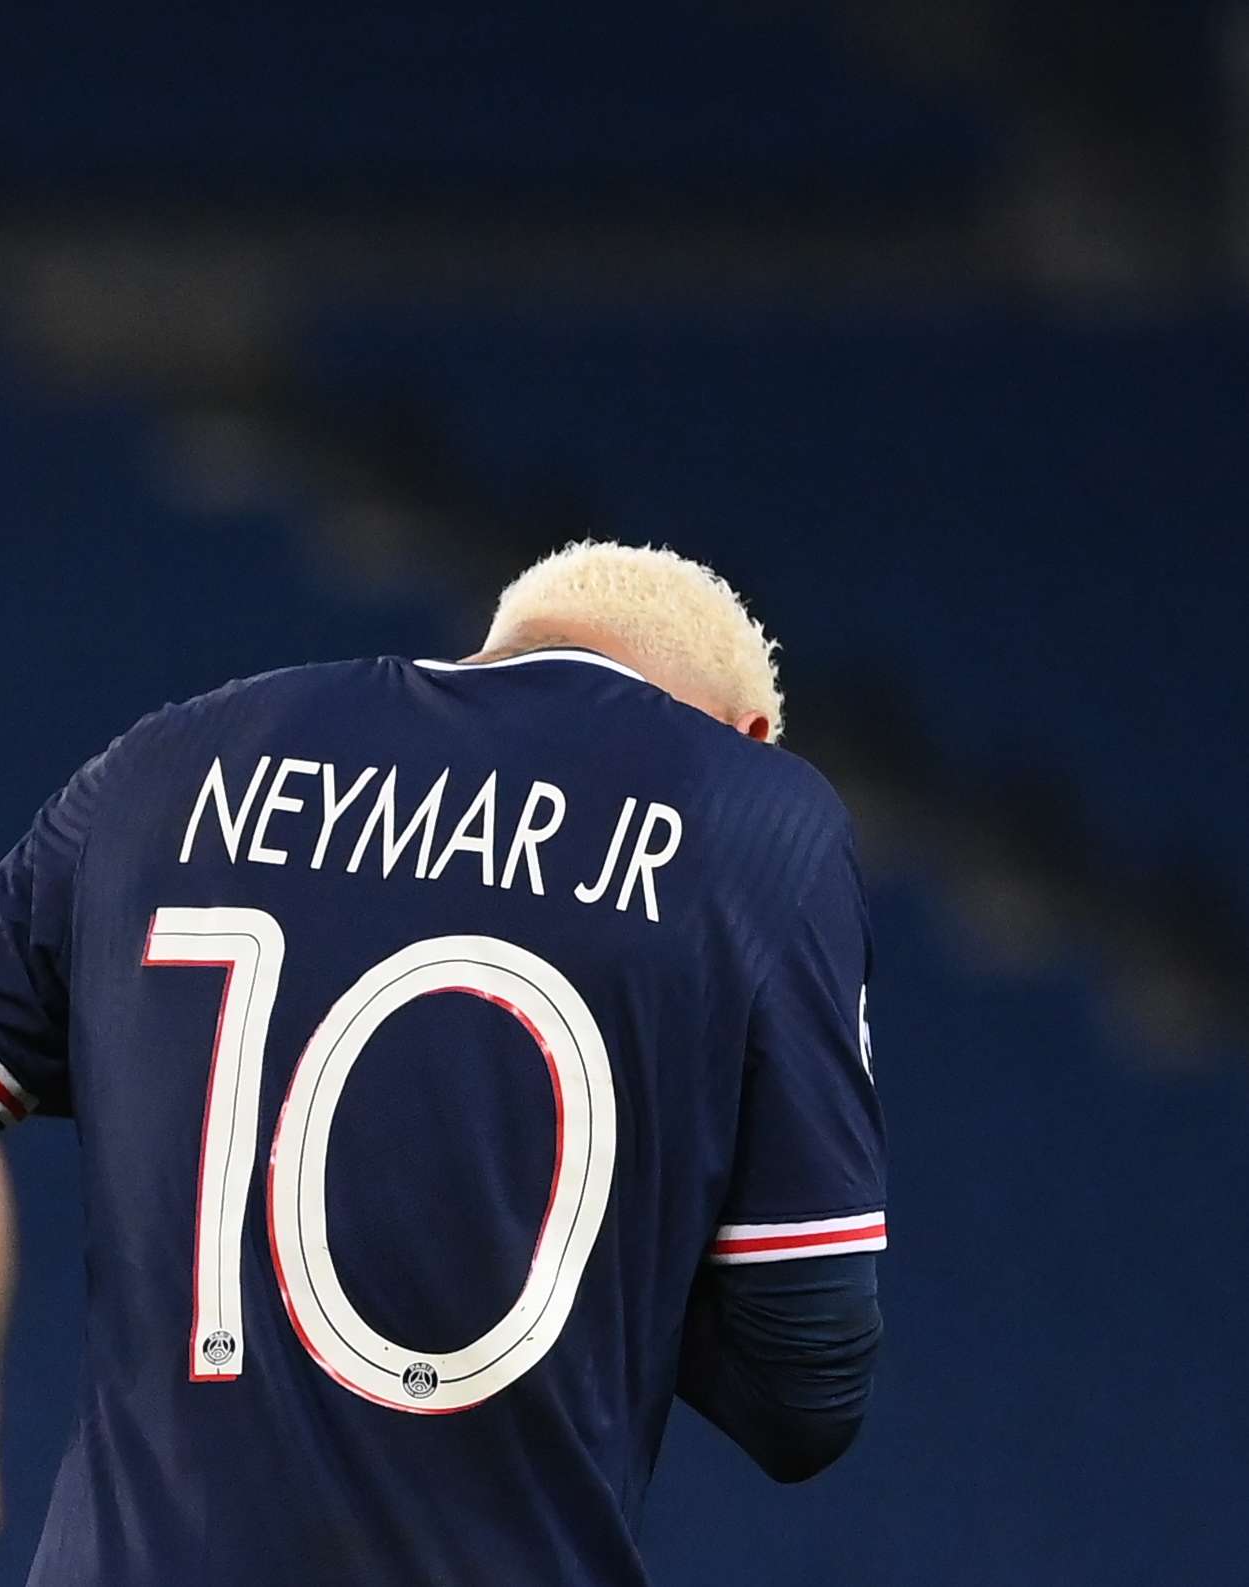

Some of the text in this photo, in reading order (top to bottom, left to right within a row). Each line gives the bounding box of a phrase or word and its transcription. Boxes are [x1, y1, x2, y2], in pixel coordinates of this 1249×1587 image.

[179, 756, 683, 923] NEYMAR JR
[141, 907, 617, 1415] 10
